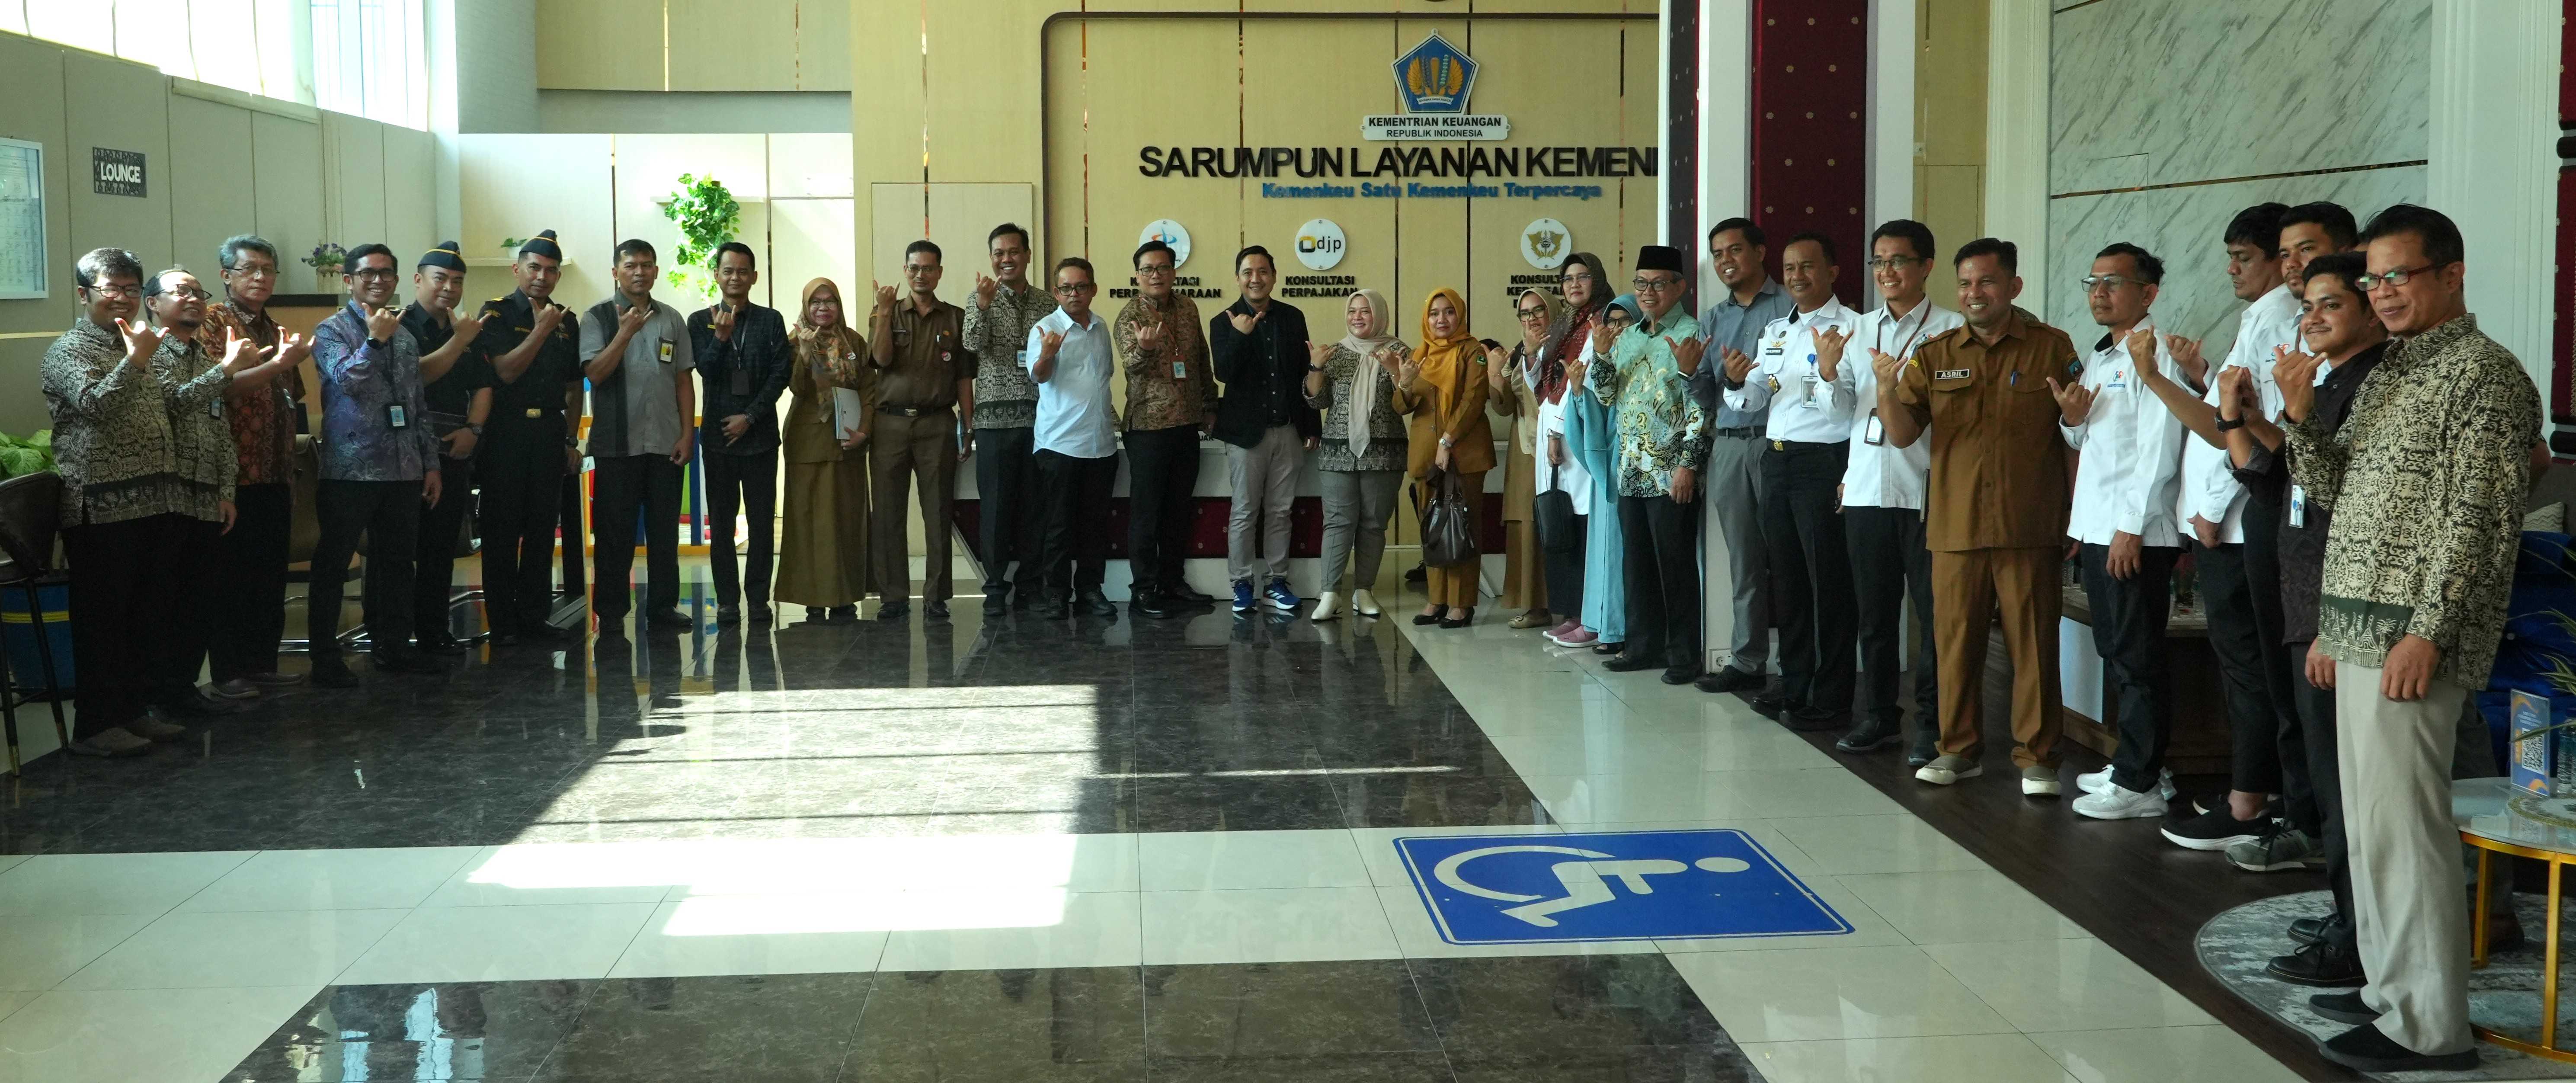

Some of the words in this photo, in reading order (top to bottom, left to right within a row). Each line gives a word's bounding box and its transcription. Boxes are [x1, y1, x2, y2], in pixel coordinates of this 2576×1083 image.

[1369, 117, 1438, 126] KEMENTRIAN
[1442, 117, 1501, 126] KEUANGAN
[1139, 146, 1343, 178] SARUMPUN
[1350, 147, 1518, 177] LAYANAN
[100, 162, 141, 183] LOUNGE
[1262, 183, 1354, 198] Kemenkeu
[1360, 182, 1402, 198] Satu
[1408, 183, 1499, 198] Kemenkeu
[1504, 182, 1602, 200] Terpercaya
[1317, 236, 1341, 253] djp
[1285, 276, 1355, 285] KONSULTASI
[1282, 288, 1357, 297] PERPAJAKAN
